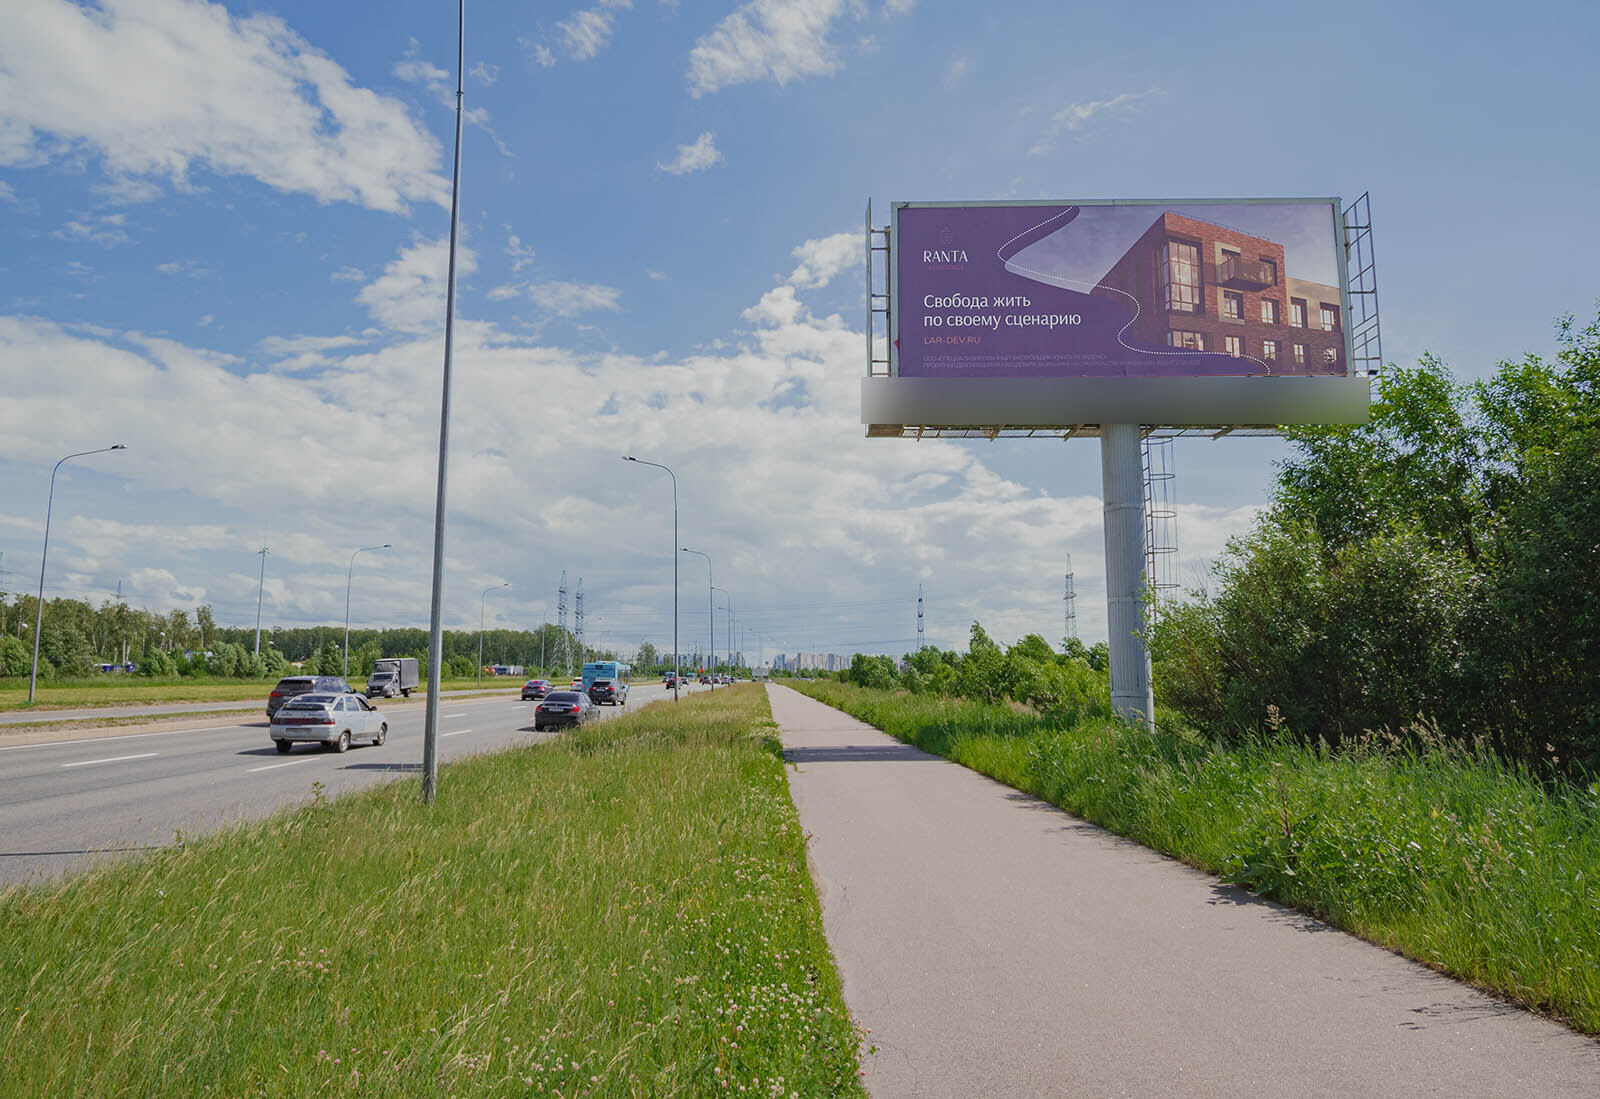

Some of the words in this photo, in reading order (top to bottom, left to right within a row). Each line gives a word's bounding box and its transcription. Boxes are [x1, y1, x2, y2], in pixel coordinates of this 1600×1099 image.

[923, 250, 969, 263] RANTA
[924, 293, 988, 309] Свобода
[993, 296, 1031, 307] жить
[924, 315, 942, 327] по
[947, 314, 1001, 330] своему
[1005, 313, 1081, 329] сценарию
[923, 336, 981, 345] LAR-DEV.RU
